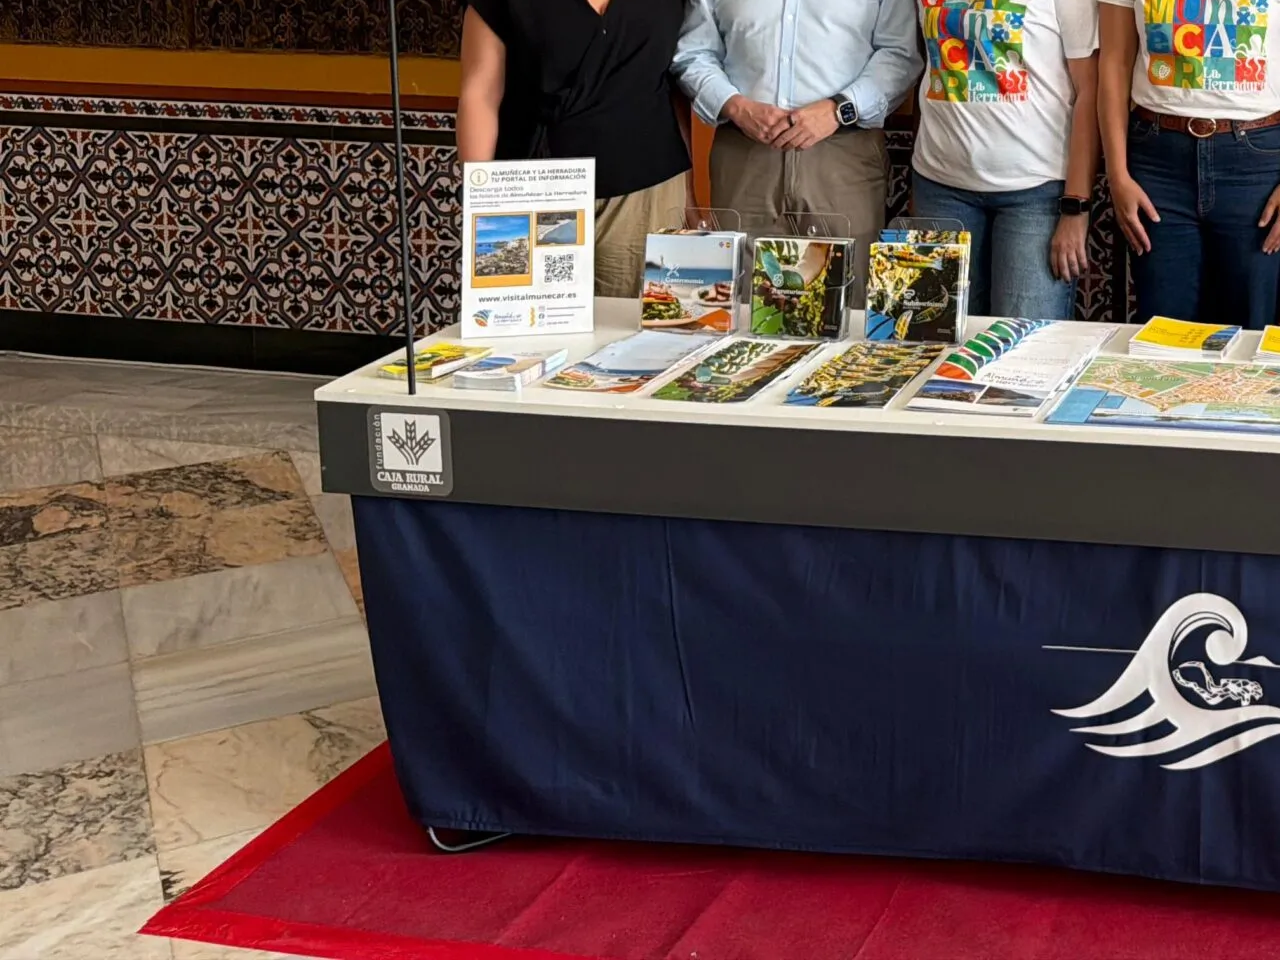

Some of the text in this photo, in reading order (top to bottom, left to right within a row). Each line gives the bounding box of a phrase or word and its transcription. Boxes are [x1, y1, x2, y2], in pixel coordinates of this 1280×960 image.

[491, 169, 531, 177] ALMUÑÉCAR
[547, 167, 587, 175] HERRADURA
[539, 173, 587, 181] INFORMACIÓN
[478, 292, 577, 303] www.visitalmunecar.es
[373, 414, 383, 470] fundación
[377, 471, 444, 485] CAJA RURAL
[391, 483, 430, 492] GRANADA
